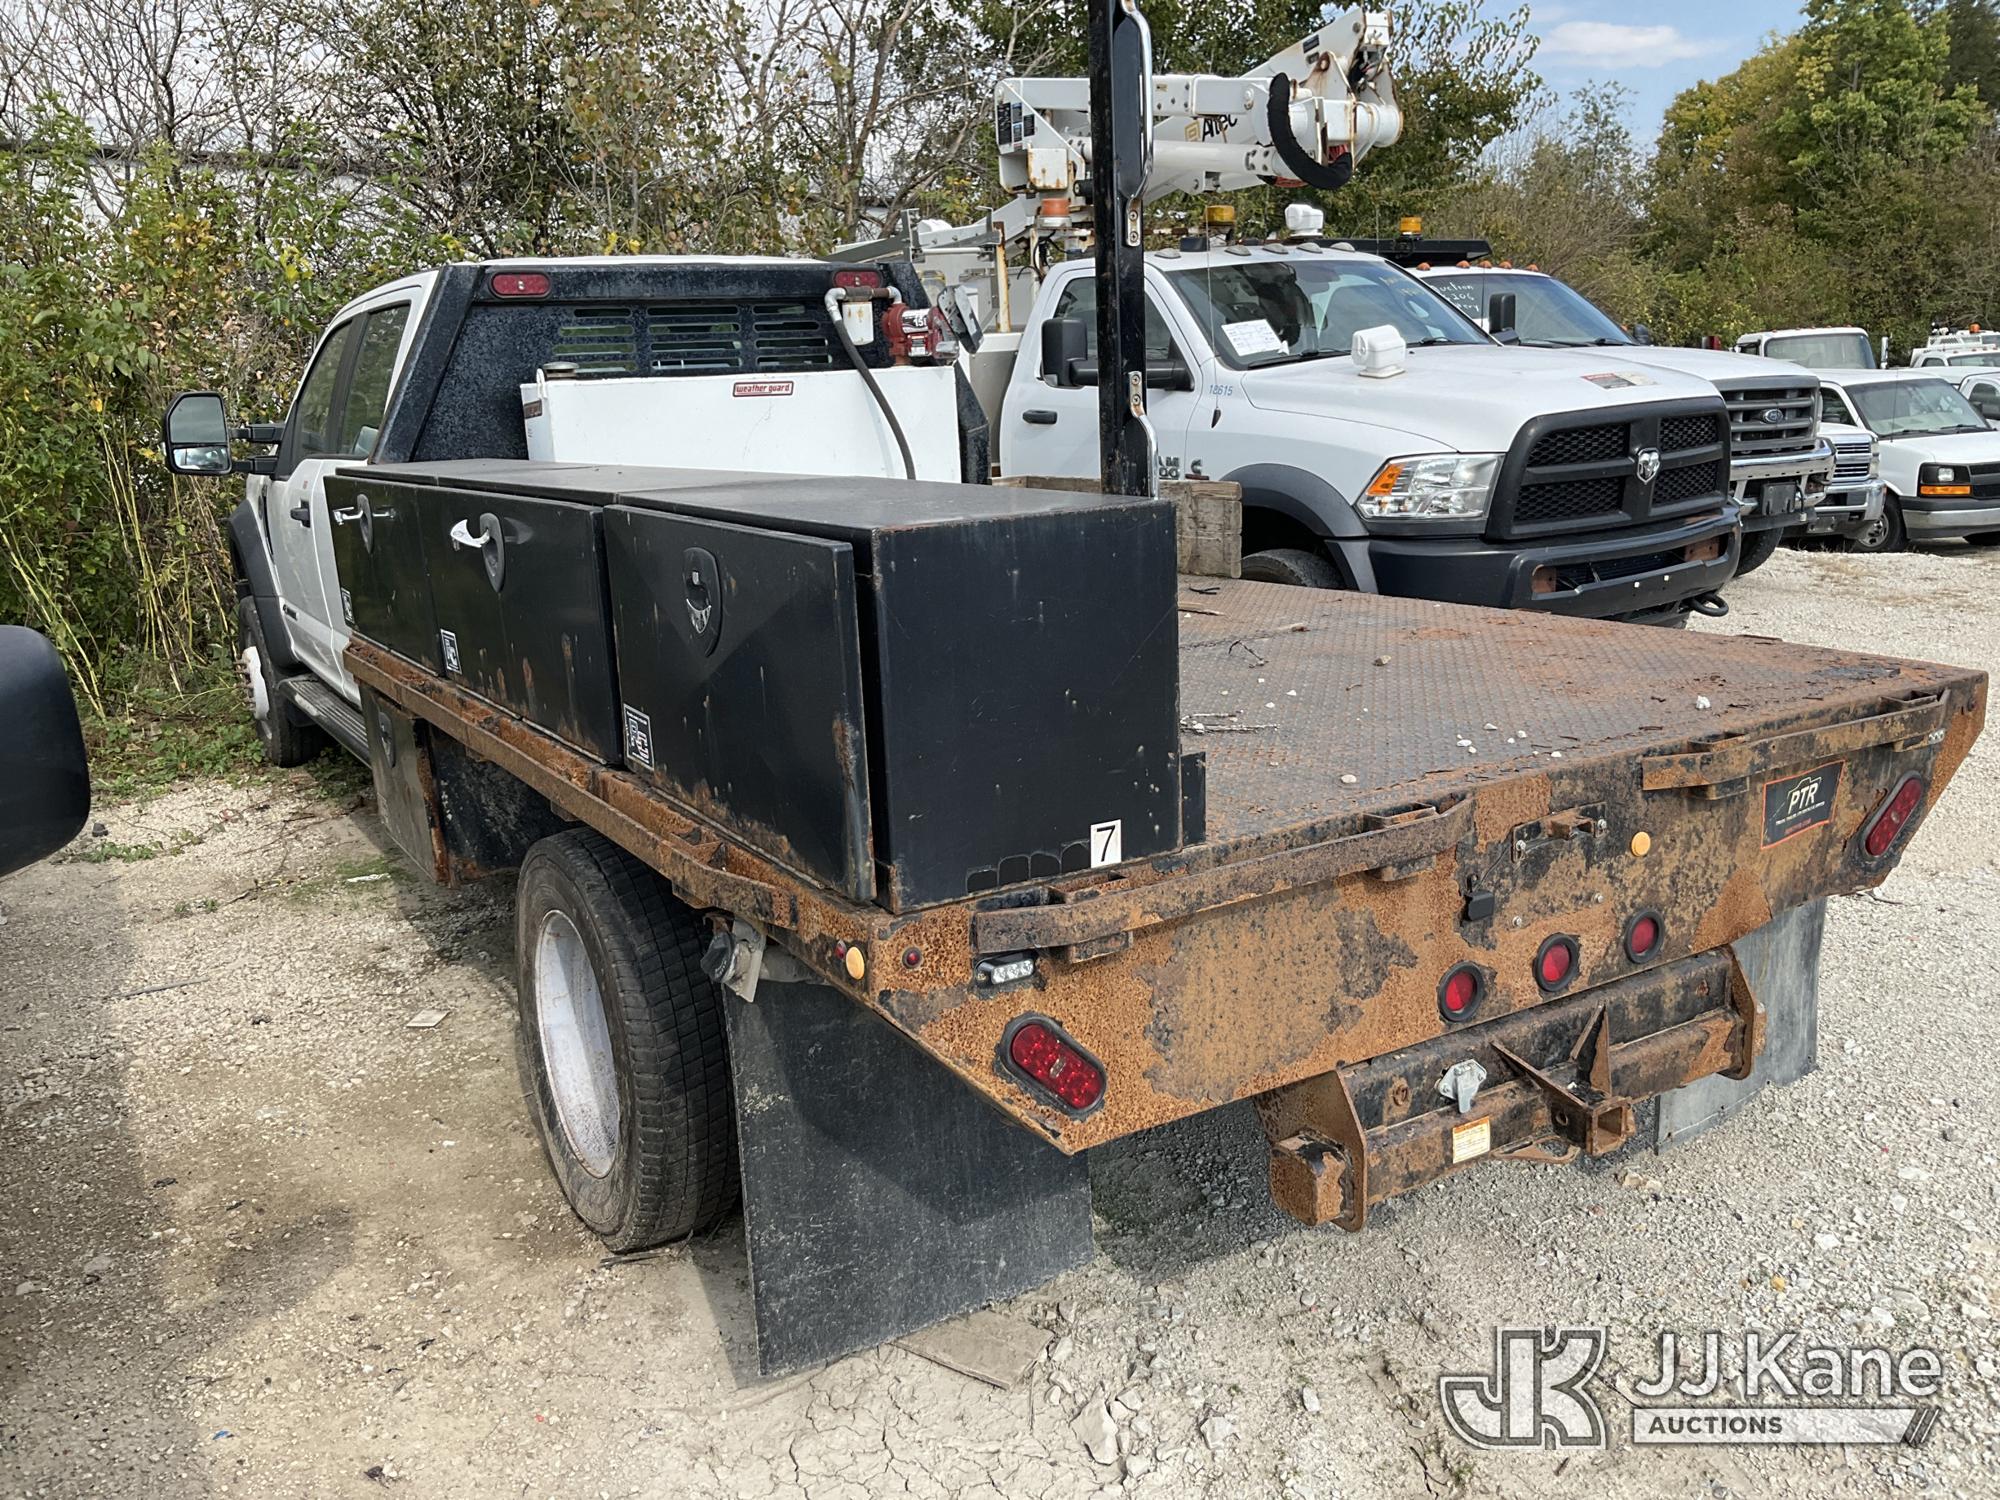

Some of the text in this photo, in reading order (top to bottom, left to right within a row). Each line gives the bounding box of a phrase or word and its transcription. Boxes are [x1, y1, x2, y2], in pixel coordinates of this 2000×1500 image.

[736, 383, 791, 393] weather guard
[1209, 384, 1233, 396] 18615
[1787, 782, 1819, 815] PTR
[1096, 824, 1116, 862] 7
